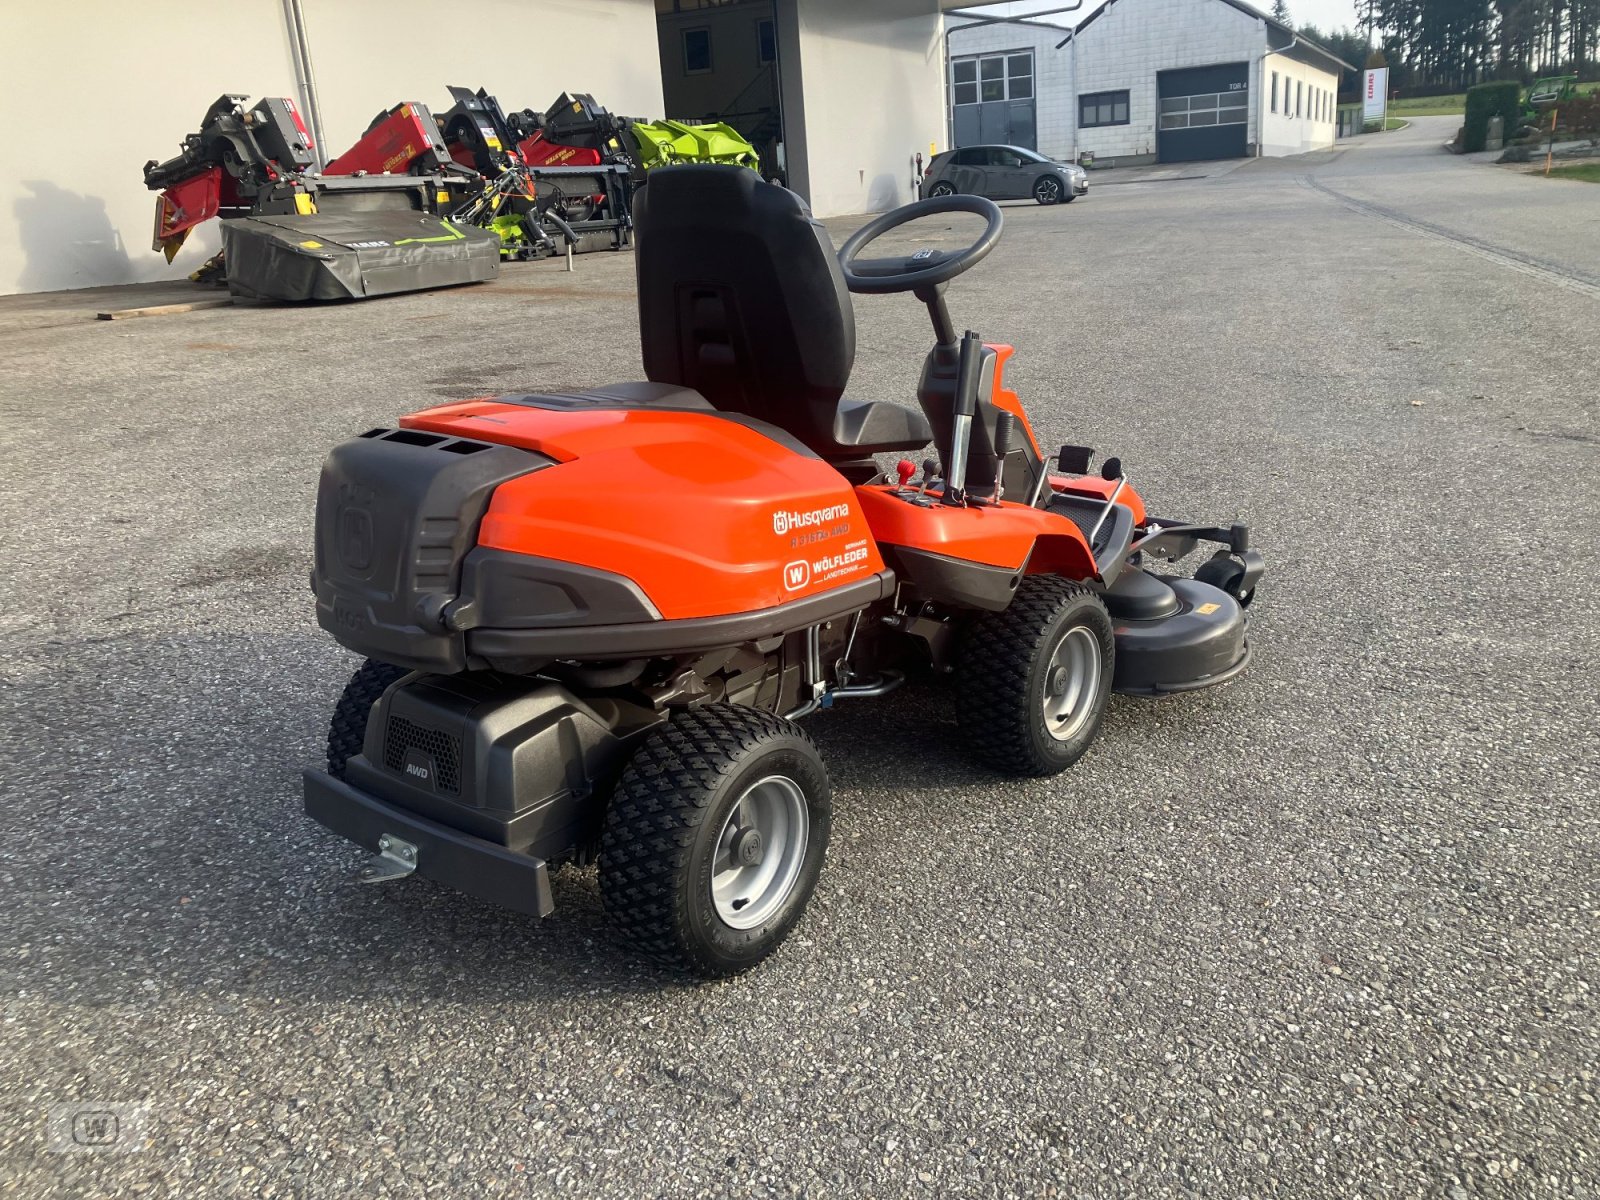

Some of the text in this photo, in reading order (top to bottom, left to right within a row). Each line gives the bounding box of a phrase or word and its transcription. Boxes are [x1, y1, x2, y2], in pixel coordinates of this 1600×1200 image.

[1229, 82, 1241, 90] TOR
[788, 503, 849, 529] Husqvarna
[812, 547, 868, 574] WÖLFLEDER
[823, 564, 859, 581] LANDTECHNIK
[406, 764, 428, 779] AWD
